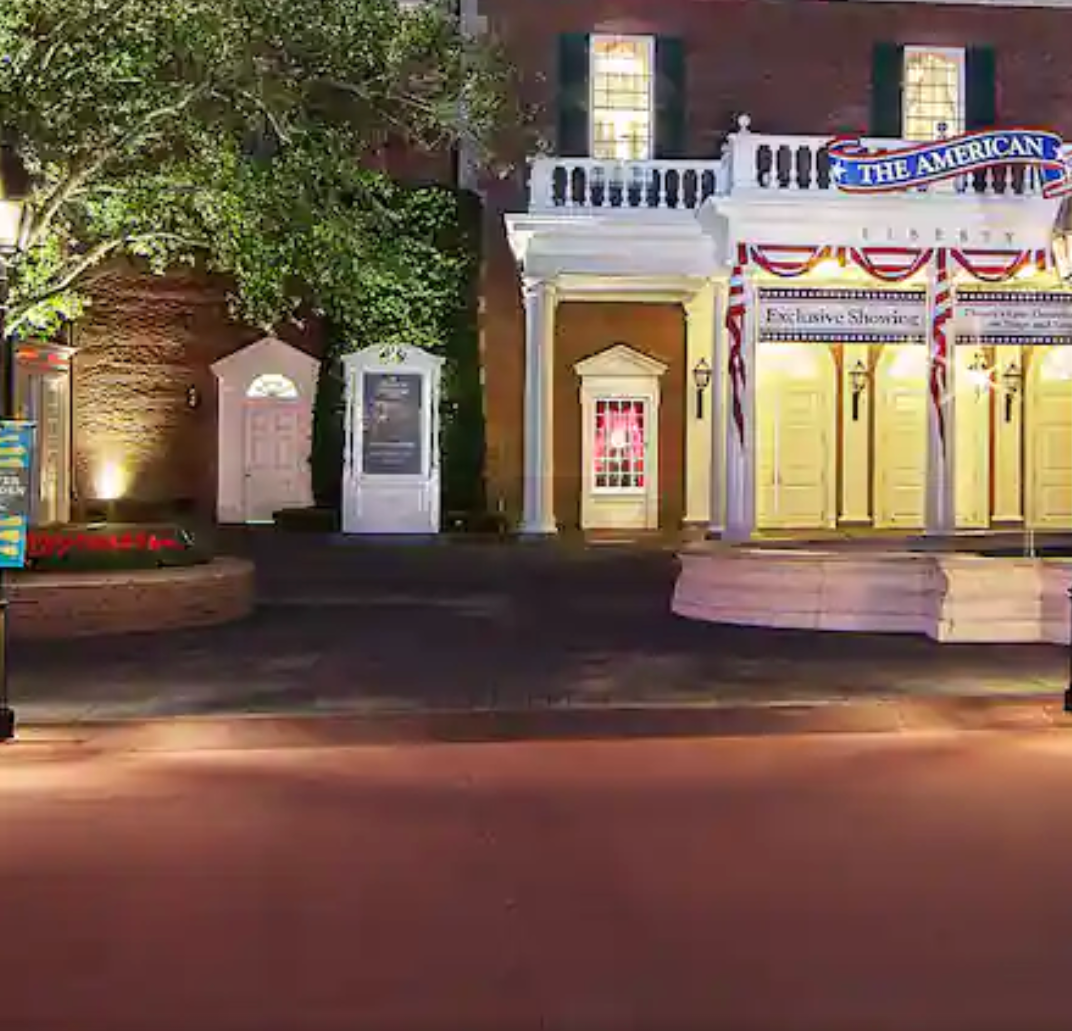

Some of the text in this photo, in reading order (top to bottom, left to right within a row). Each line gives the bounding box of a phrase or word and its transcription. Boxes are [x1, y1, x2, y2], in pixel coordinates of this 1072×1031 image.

[857, 160, 909, 184] THE
[916, 136, 1044, 175] AMERICAN
[862, 227, 1015, 244] LIBERTY
[766, 307, 919, 326] Exclusive Showing
